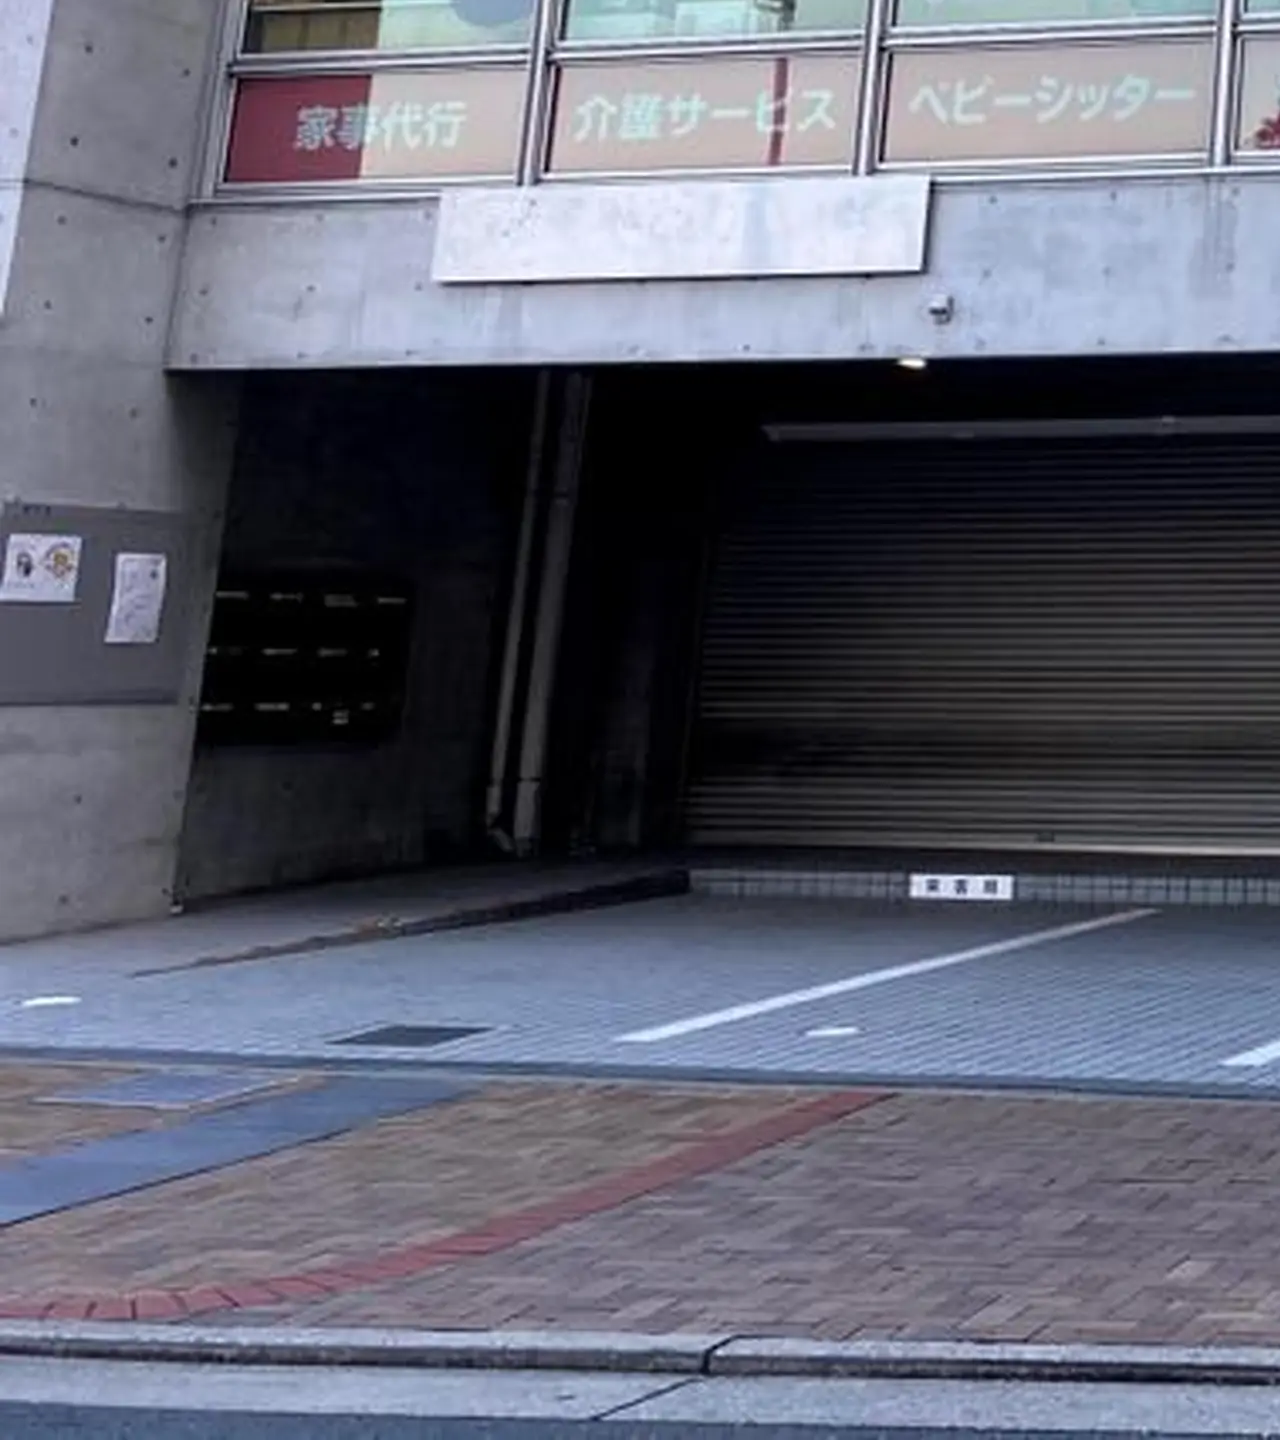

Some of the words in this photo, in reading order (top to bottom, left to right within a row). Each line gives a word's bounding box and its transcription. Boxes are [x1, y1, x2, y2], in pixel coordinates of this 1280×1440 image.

[295, 100, 468, 153] 家事代行
[574, 87, 837, 143] 介護サービス
